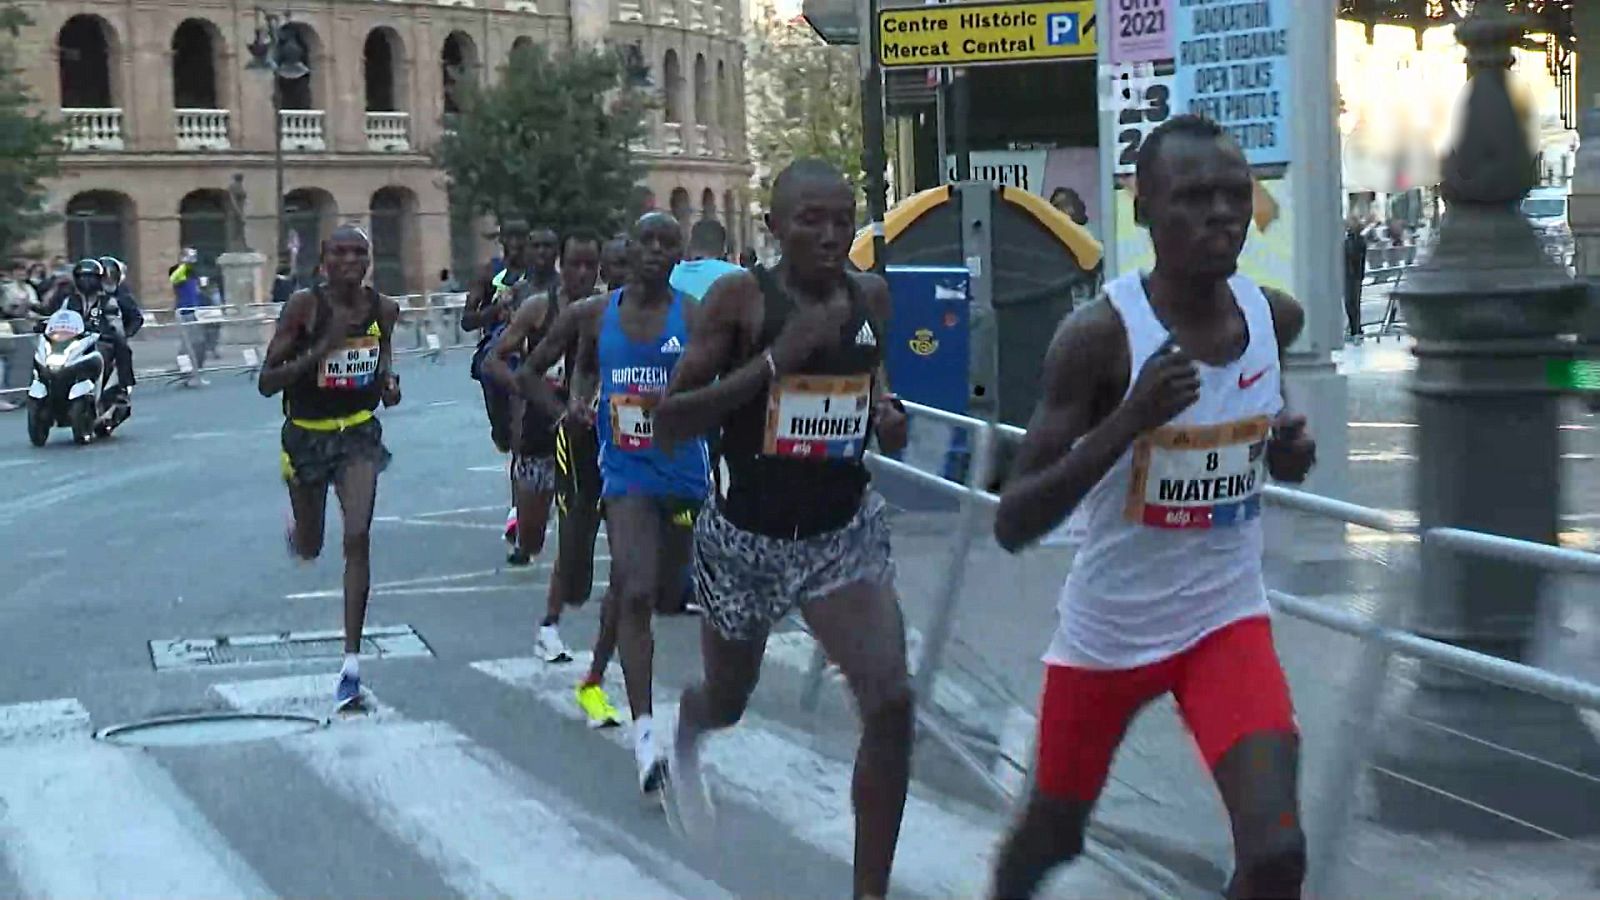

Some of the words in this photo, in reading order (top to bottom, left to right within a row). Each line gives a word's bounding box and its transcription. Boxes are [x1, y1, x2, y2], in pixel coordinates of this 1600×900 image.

[883, 17, 948, 33] Centre
[1119, 9, 1165, 37] 2021
[883, 41, 950, 59] Mercat
[962, 35, 1036, 55] Central
[823, 396, 831, 413] 1
[790, 417, 862, 436] RHONEX
[1206, 452, 1219, 472] 8
[1159, 470, 1256, 500] MATEIKO
